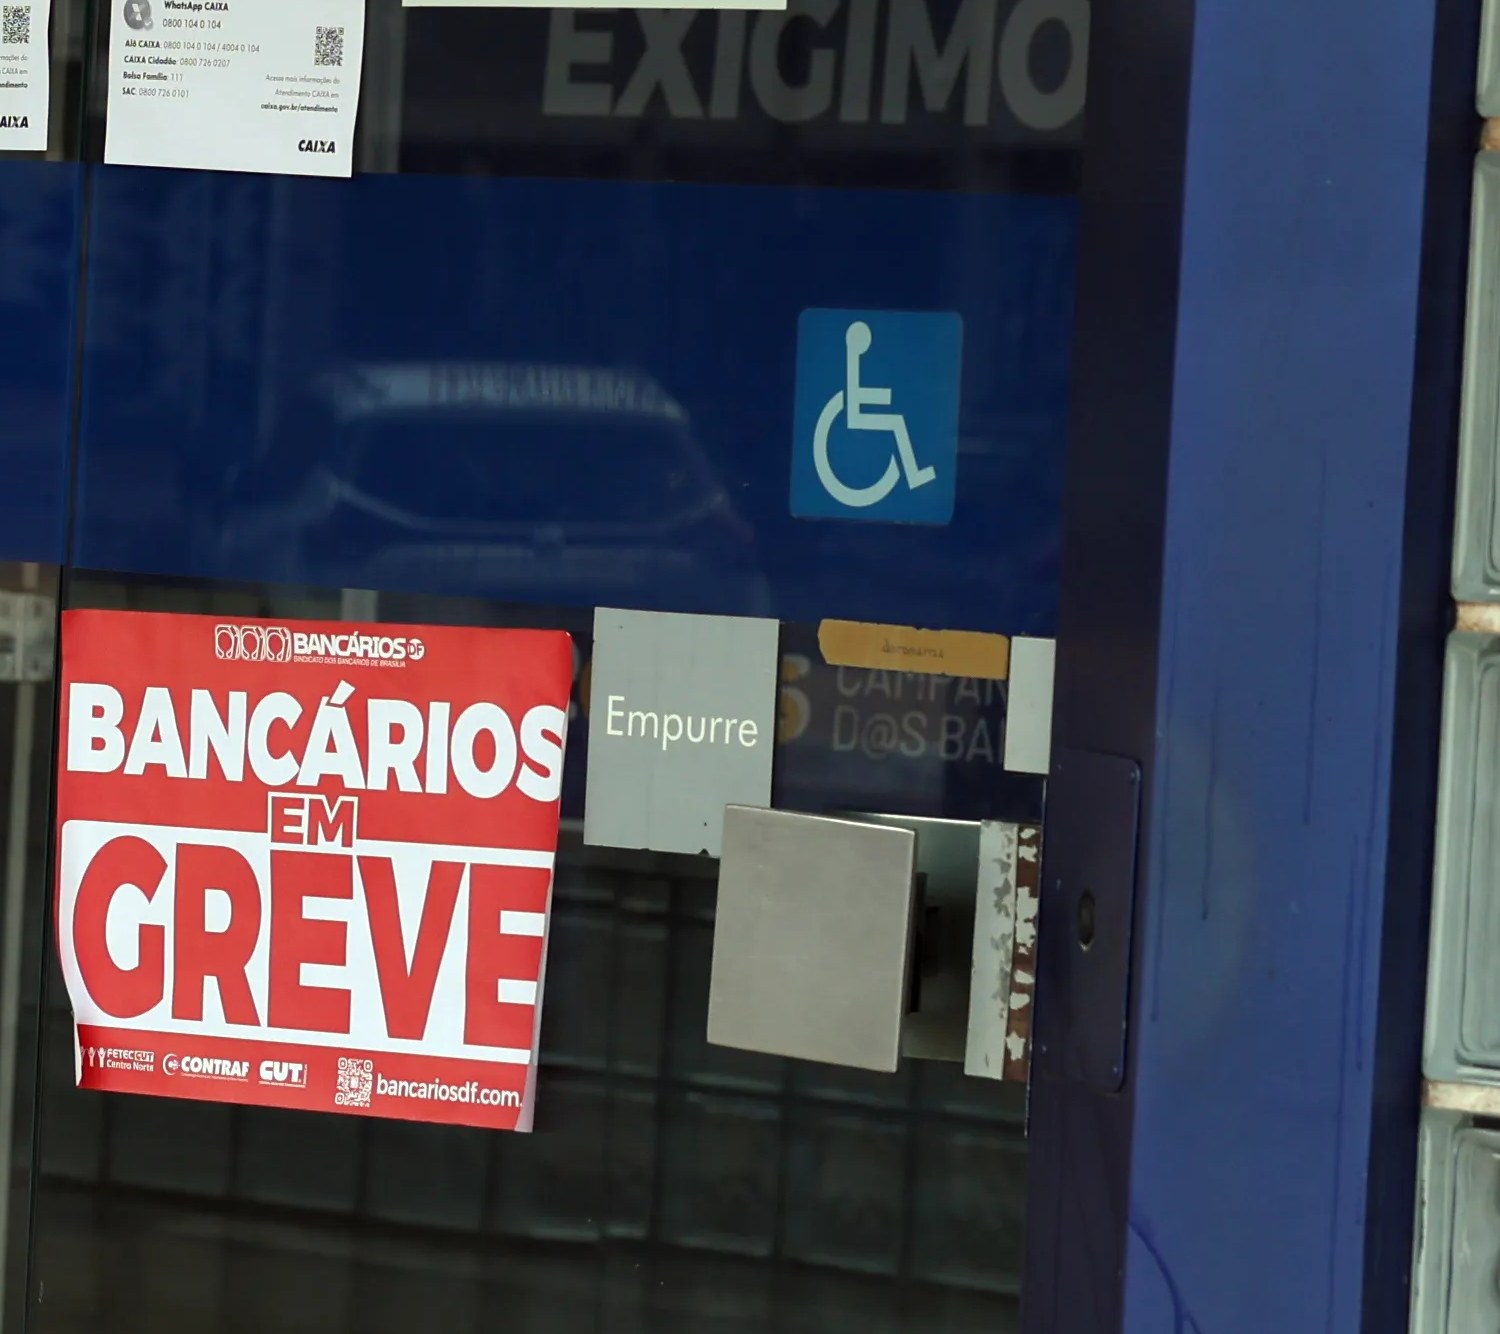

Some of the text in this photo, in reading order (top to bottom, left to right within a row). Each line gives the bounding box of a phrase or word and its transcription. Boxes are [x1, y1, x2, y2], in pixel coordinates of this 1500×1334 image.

[294, 632, 406, 661] BANCÁRIOS
[67, 680, 565, 802] BANCÁRIOS
[605, 695, 759, 751] Empurre
[269, 791, 358, 848] EM
[73, 835, 551, 1050] GREVE
[181, 1057, 249, 1078] CONTRAF
[260, 1061, 302, 1083] CUT
